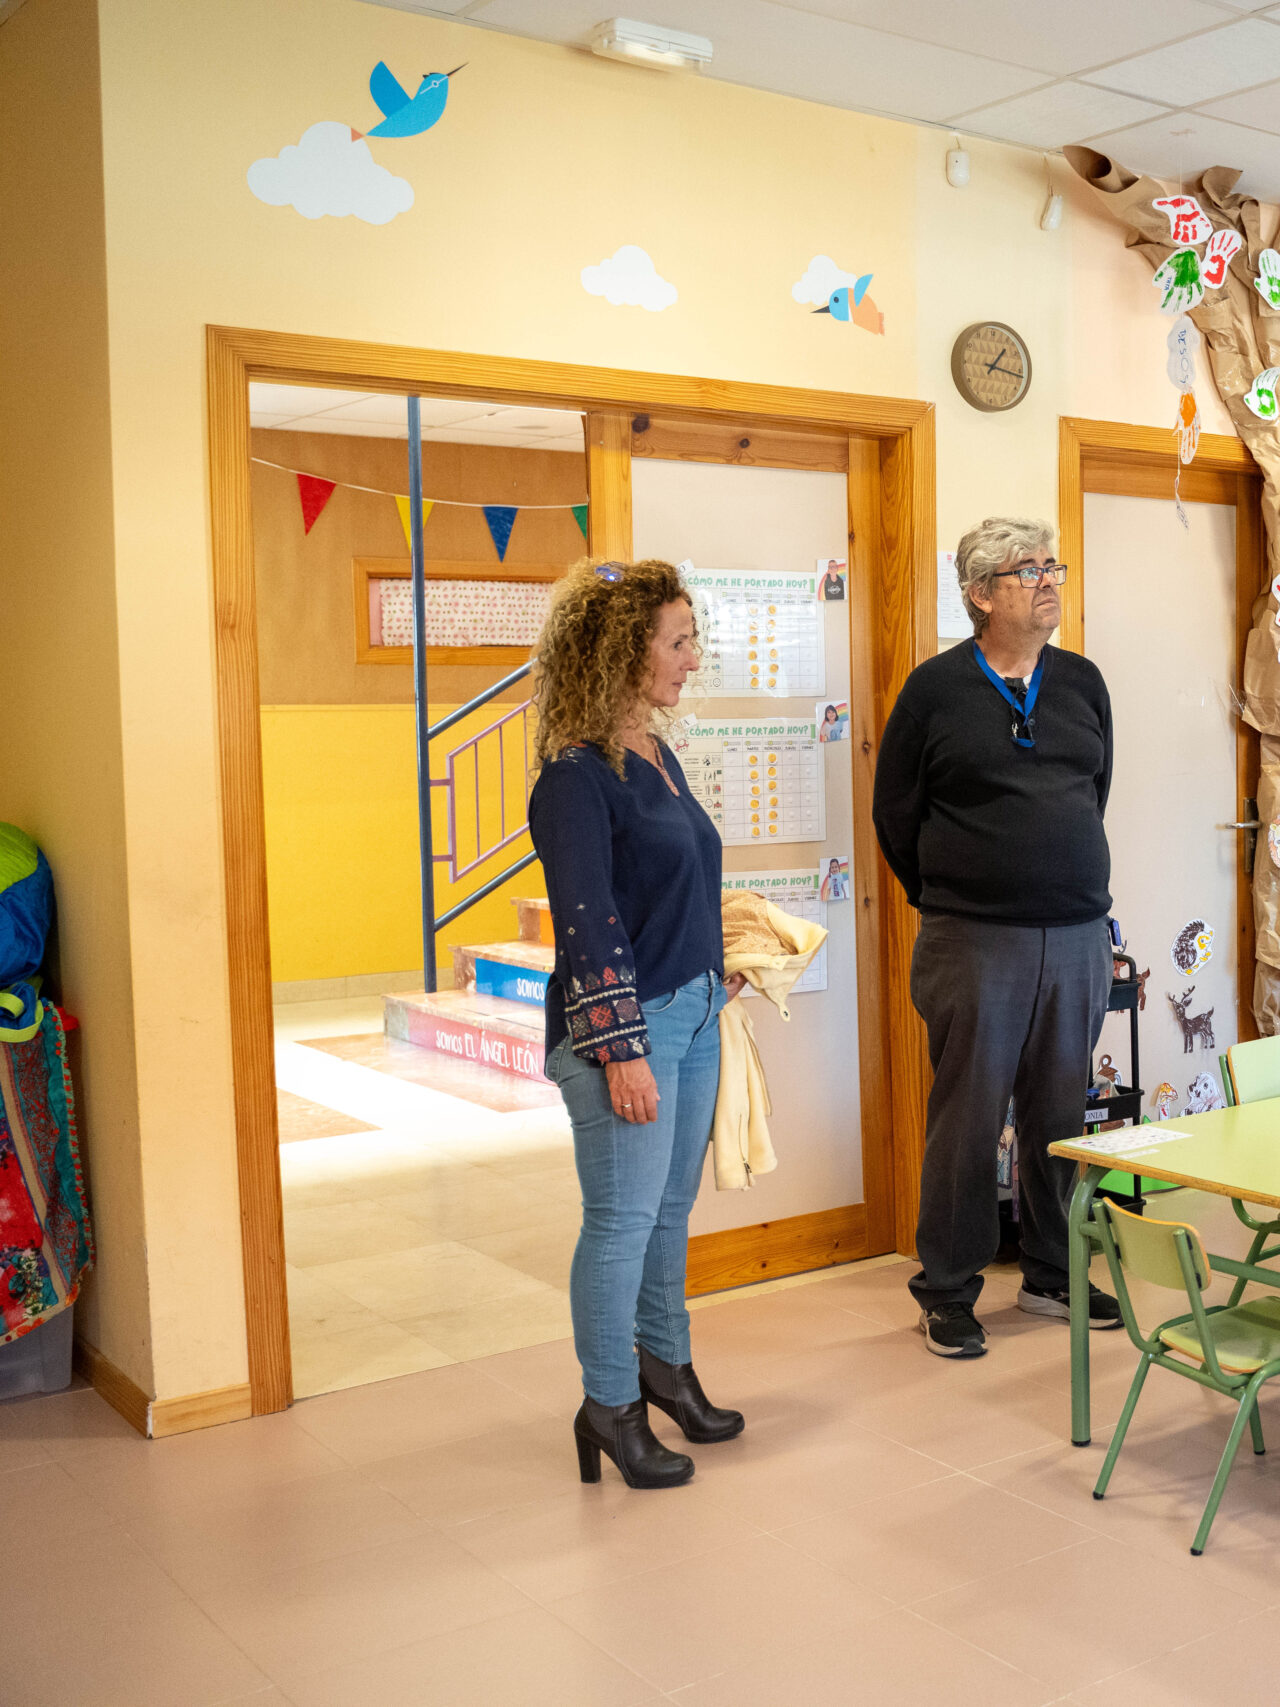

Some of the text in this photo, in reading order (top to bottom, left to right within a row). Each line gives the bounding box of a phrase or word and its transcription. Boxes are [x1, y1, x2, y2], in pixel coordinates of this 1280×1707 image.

[731, 577, 741, 587] HE
[744, 577, 783, 588] PORTADO
[717, 726, 729, 736] ME
[732, 726, 743, 736] HE
[745, 726, 784, 736] PORTADO
[735, 879, 746, 889] HE
[749, 878, 787, 889] PORTADO
[464, 1032, 477, 1058] EL
[480, 1030, 511, 1067] ÁNGEL
[512, 1043, 539, 1074] LEÓN
